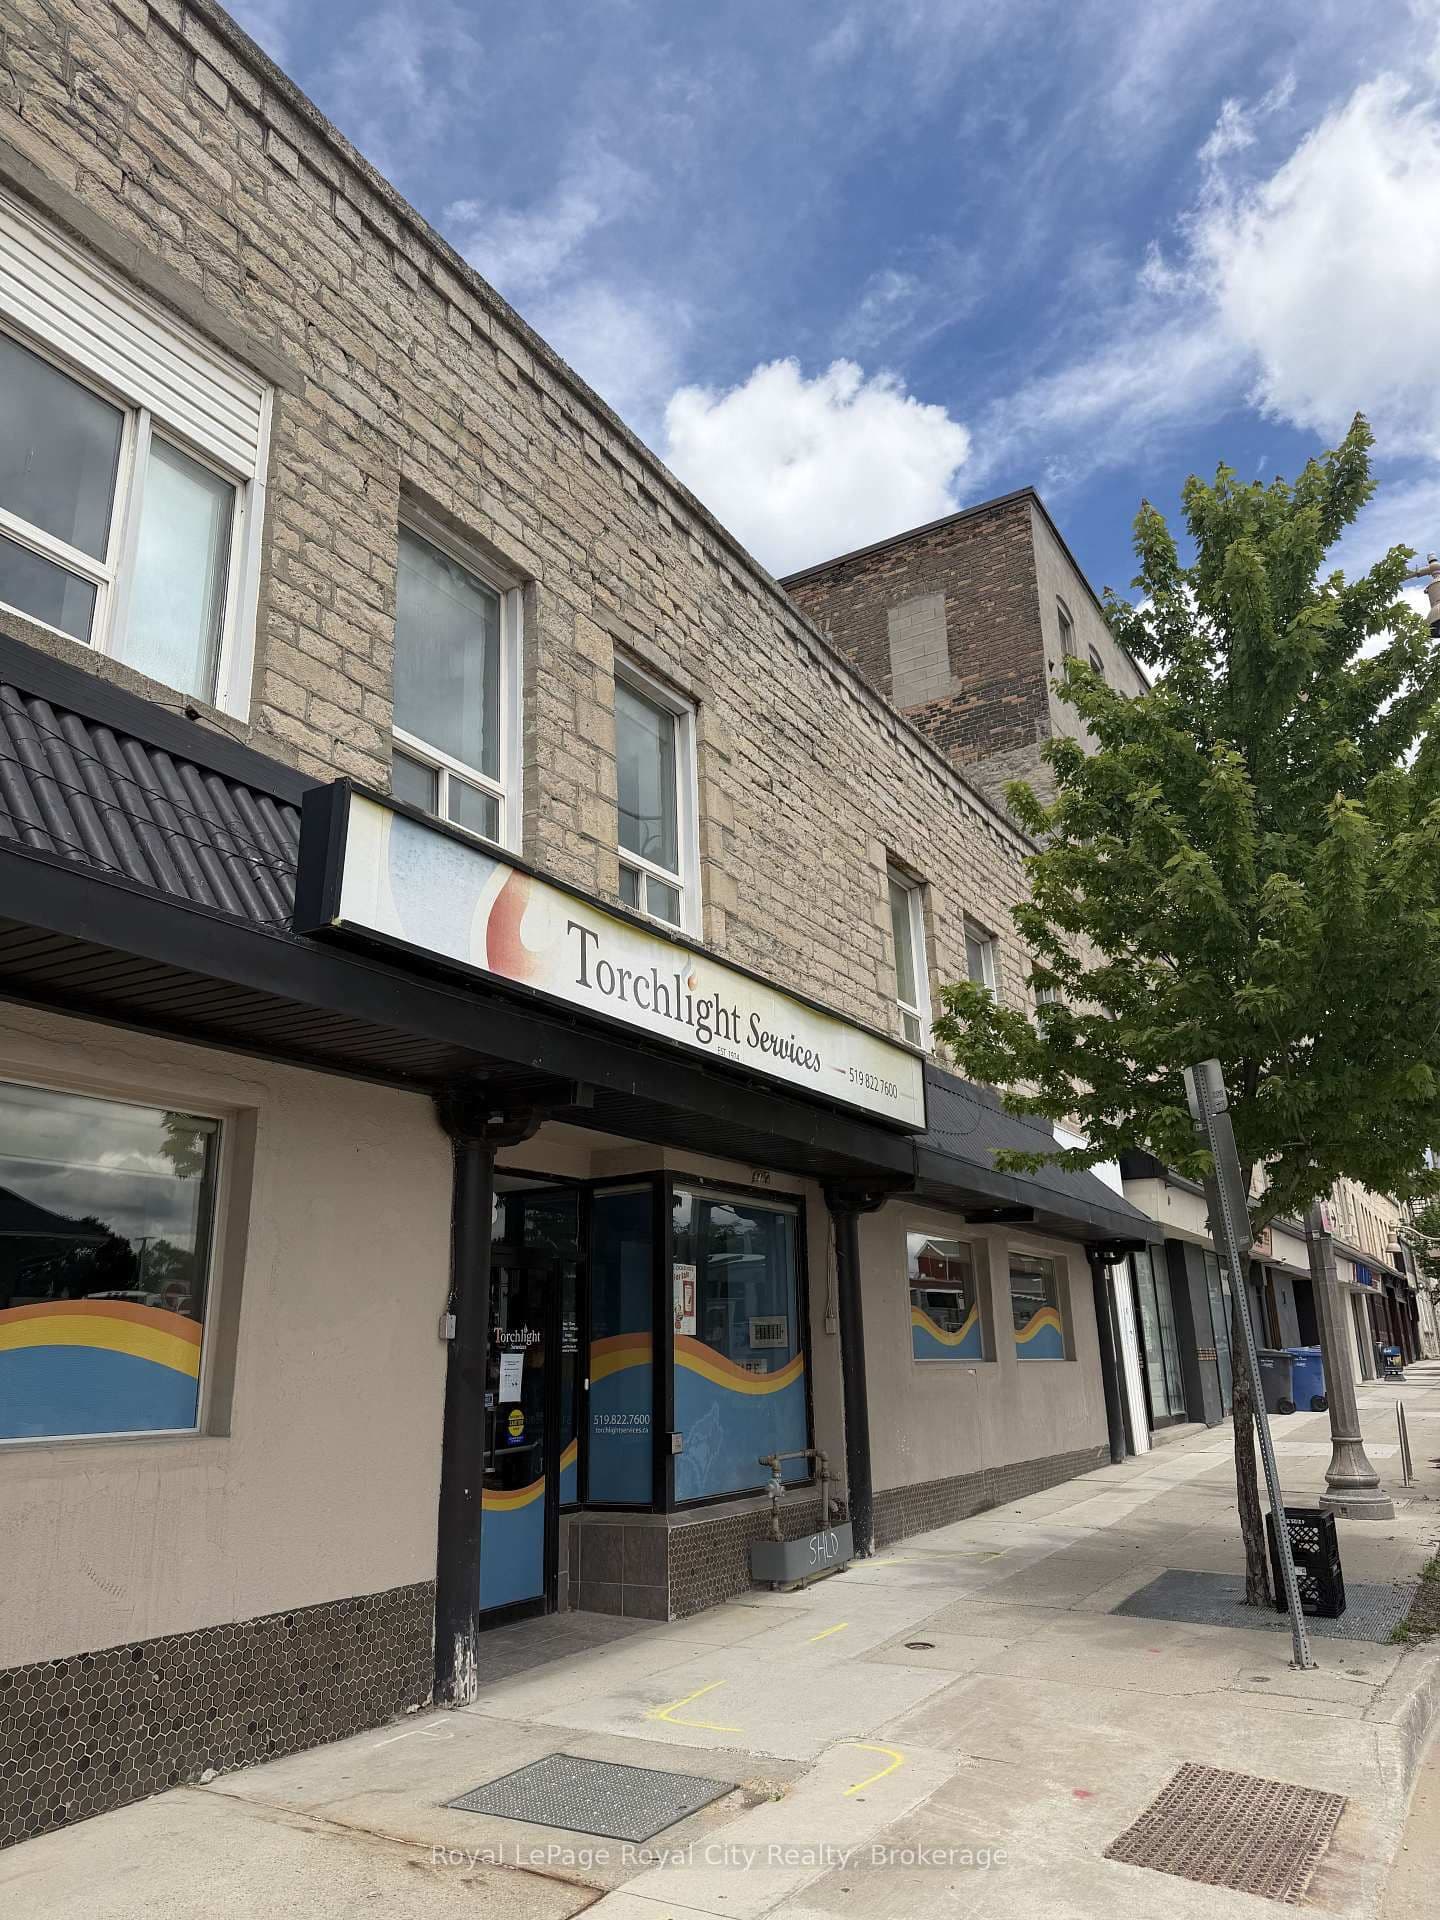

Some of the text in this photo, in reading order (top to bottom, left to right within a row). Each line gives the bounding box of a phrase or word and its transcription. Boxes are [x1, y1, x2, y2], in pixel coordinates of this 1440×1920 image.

[567, 919, 822, 1073] Torchlight Services
[493, 1327, 541, 1346] Torchlight
[593, 1414, 650, 1425] 519.822.7600
[595, 1426, 649, 1435] torchlightservices.ca
